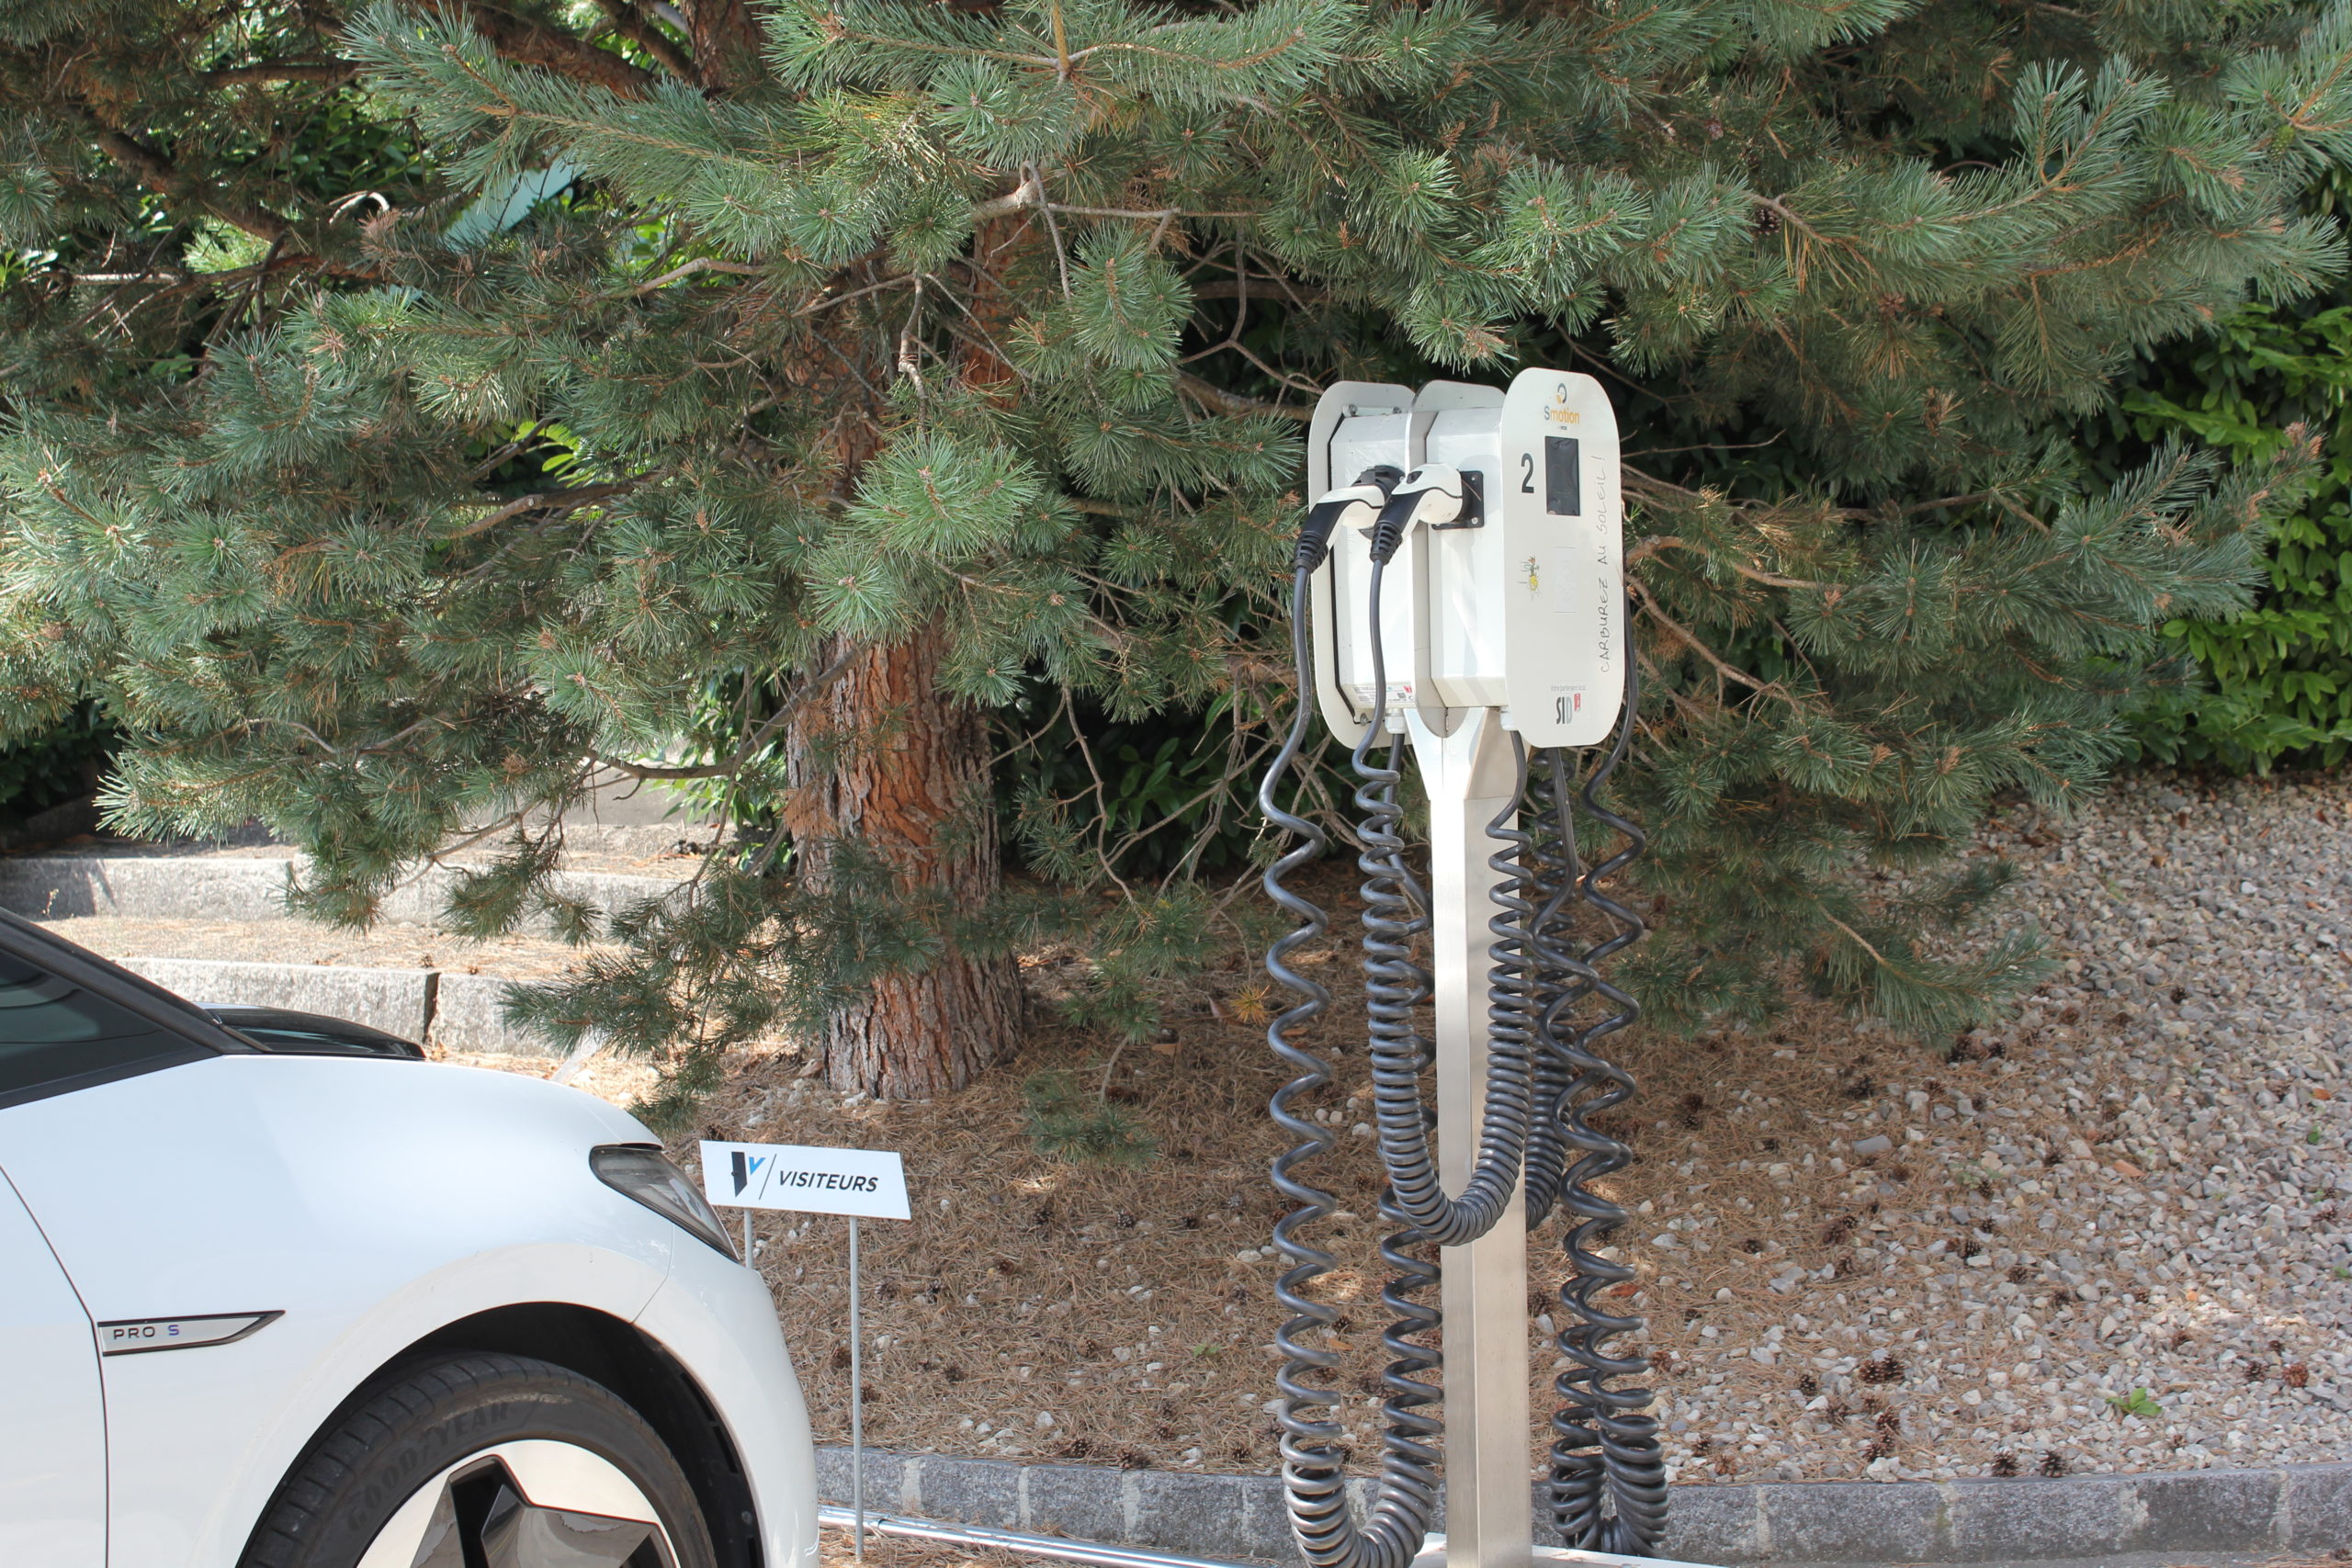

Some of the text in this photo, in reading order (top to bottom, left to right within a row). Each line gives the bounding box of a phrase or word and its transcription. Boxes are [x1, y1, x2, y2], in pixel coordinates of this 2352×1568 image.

[1544, 405, 1579, 424] Smotion
[1521, 452, 1534, 493] 2
[1598, 545, 1609, 565] AU
[1599, 577, 1611, 672] CARBUREZ
[1555, 696, 1573, 724] SID
[779, 1170, 878, 1192] VISITEURS
[113, 1325, 179, 1340] PRO S
